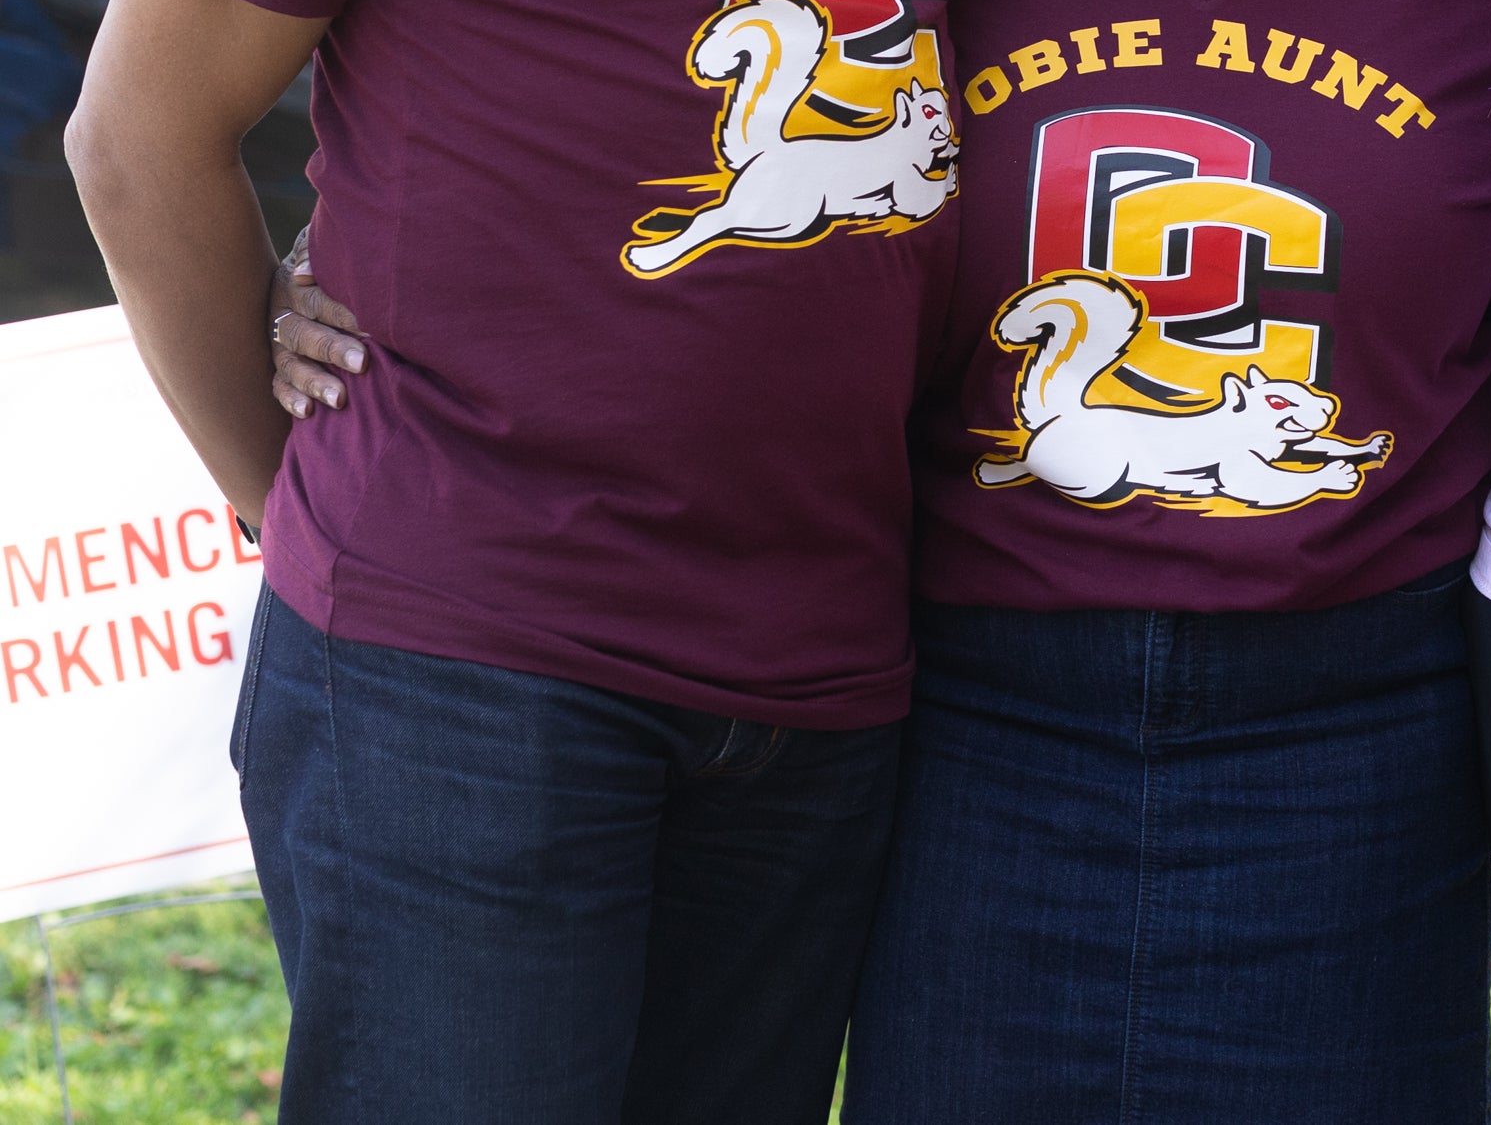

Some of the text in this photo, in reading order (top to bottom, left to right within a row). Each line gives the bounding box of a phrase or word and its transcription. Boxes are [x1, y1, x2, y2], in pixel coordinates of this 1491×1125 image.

[964, 18, 1437, 139] OBIE AUNT
[0, 601, 234, 703] RKING
